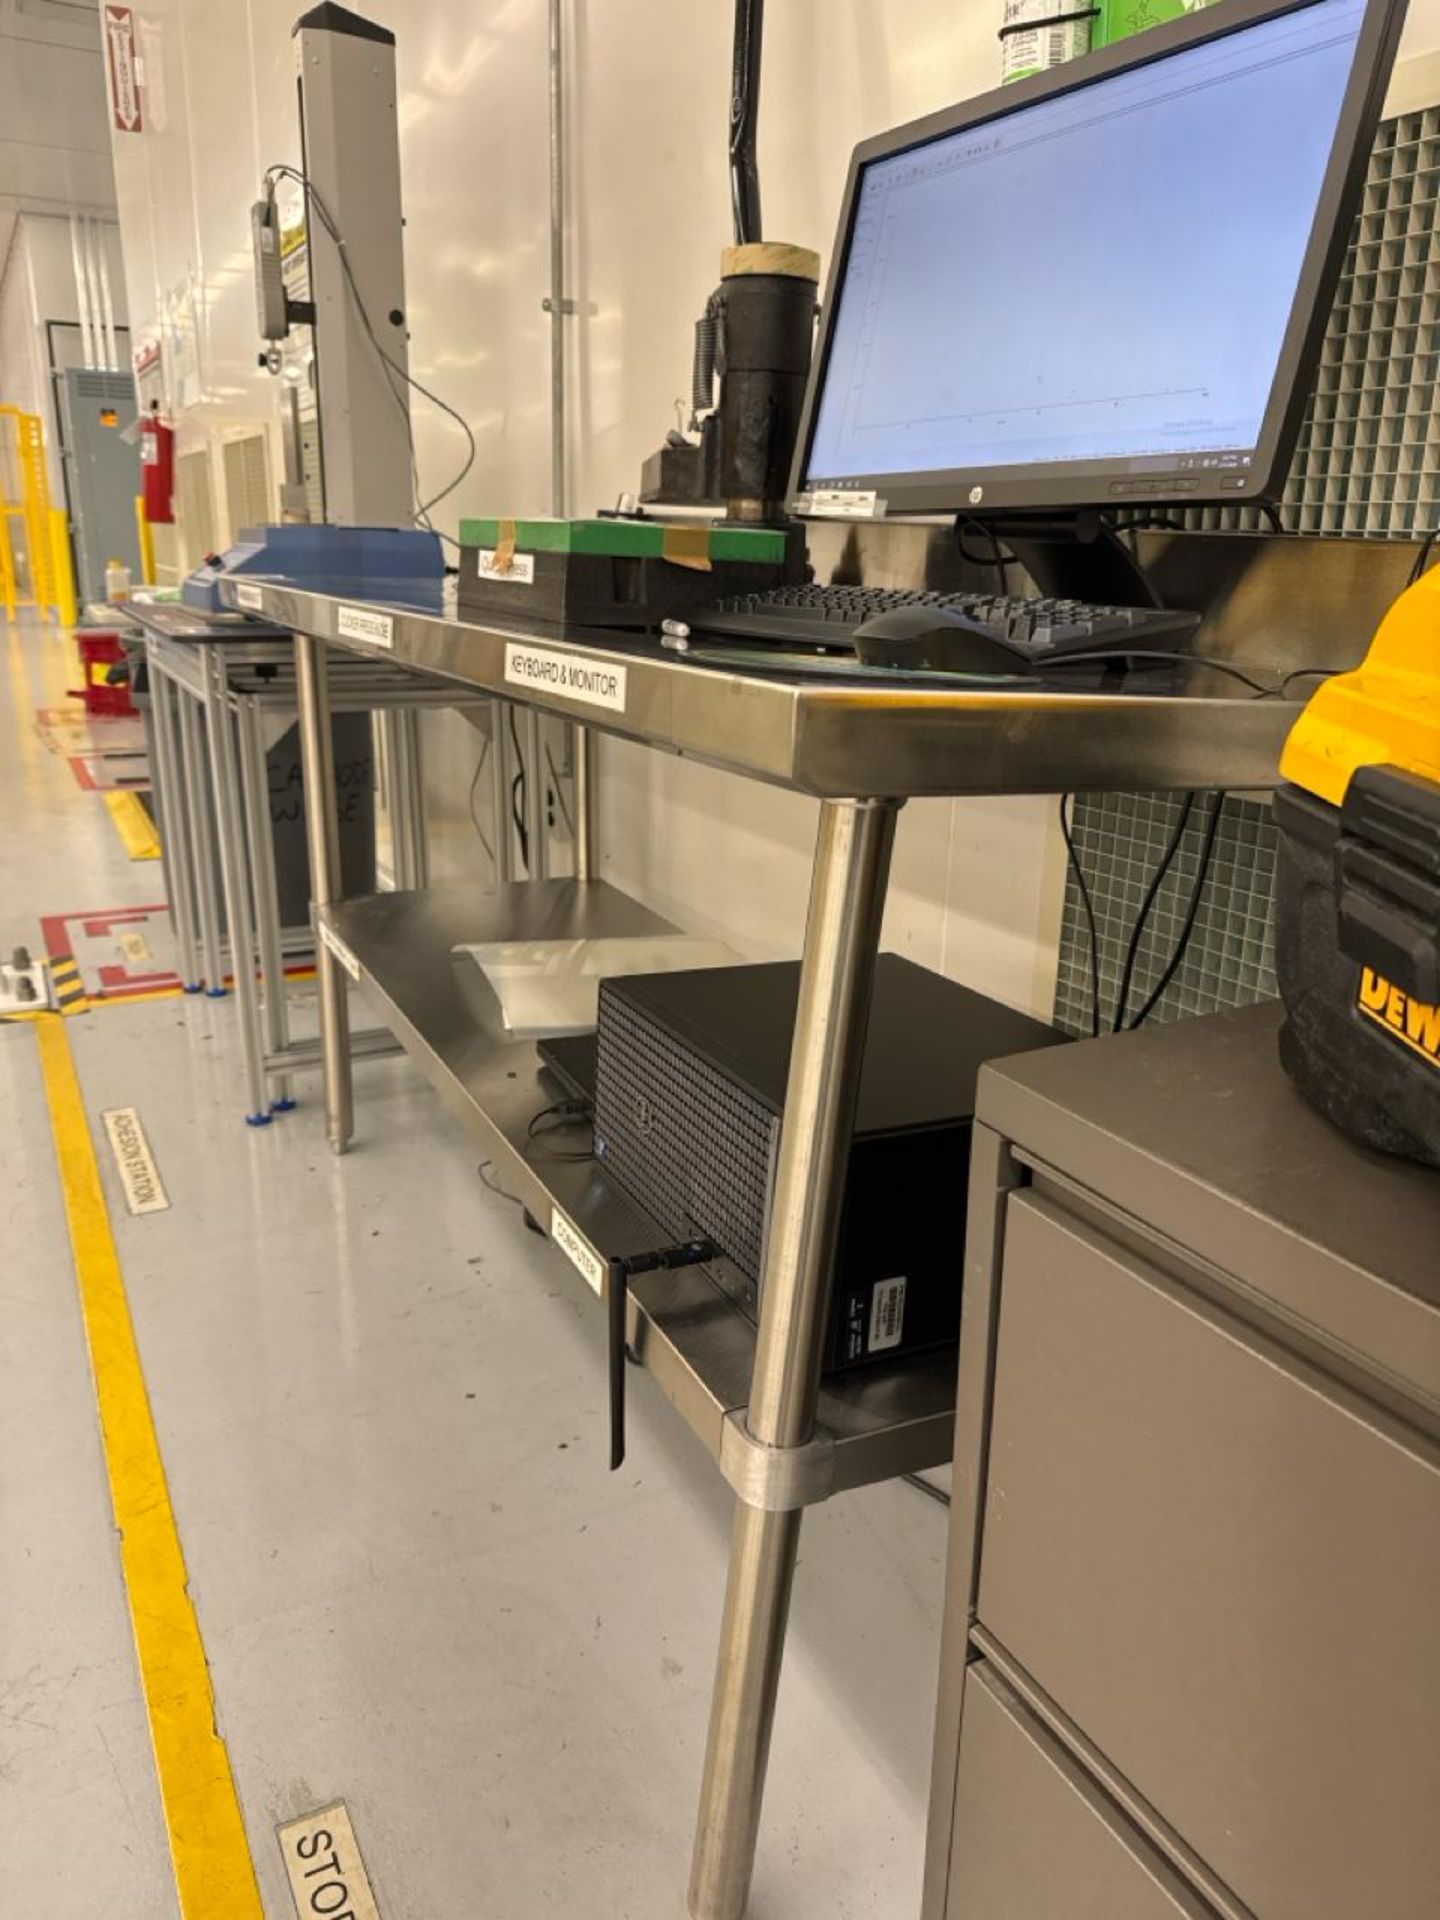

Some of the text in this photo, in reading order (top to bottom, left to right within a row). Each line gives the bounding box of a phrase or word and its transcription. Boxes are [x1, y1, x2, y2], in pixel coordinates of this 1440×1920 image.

[512, 655, 617, 696] KEYBOARD & MONITOR
[125, 1158, 158, 1205] STATION
